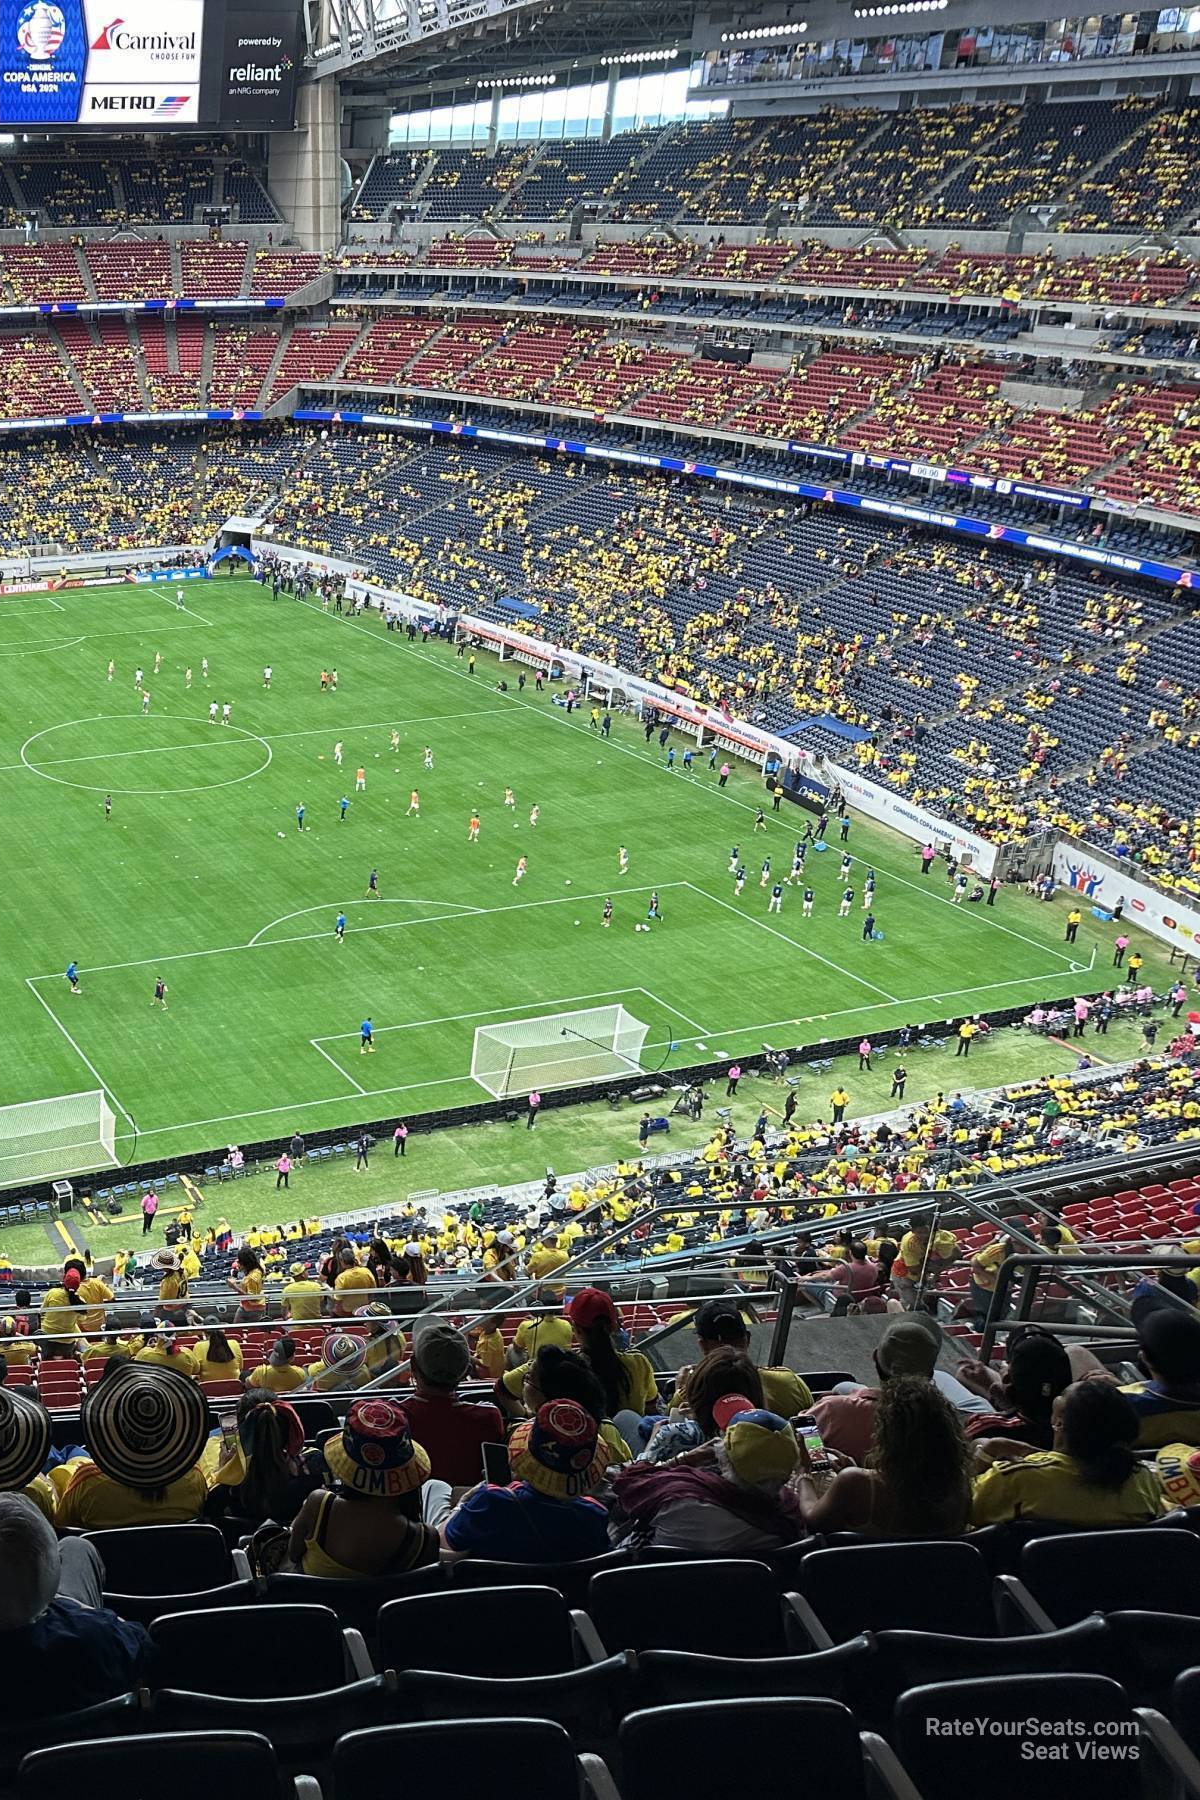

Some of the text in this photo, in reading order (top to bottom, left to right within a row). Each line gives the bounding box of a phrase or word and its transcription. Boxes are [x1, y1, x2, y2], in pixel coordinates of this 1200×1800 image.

[116, 32, 195, 50] Carnival
[238, 37, 282, 47] powered by
[3, 72, 31, 82] COPA
[229, 63, 282, 81] reliant
[21, 84, 59, 93] USA 2024
[237, 87, 251, 95] NRG
[252, 88, 280, 96] company
[91, 96, 156, 110] METRO
[893, 804, 920, 824] CONMEBOL
[920, 819, 933, 831] COPA
[933, 826, 956, 843] AMERICA
[967, 843, 980, 855] 2024
